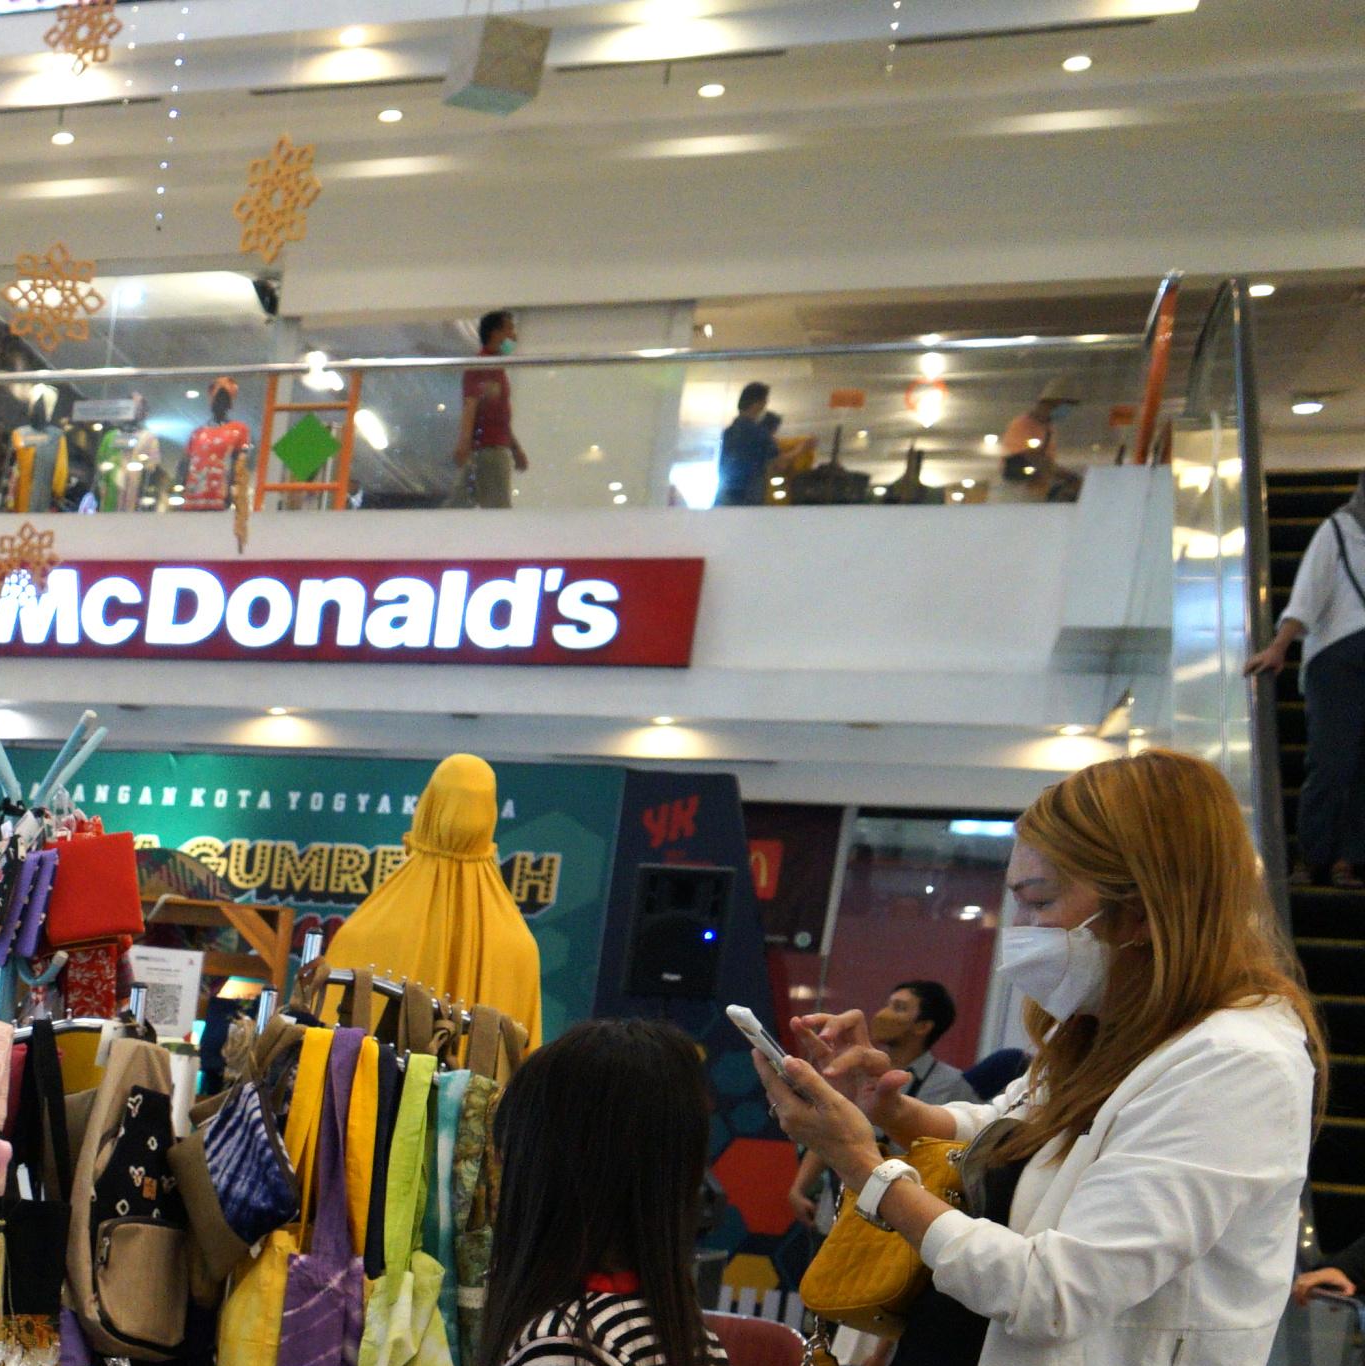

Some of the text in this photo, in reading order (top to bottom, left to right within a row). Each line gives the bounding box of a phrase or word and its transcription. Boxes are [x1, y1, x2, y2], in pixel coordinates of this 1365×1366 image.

[190, 786, 272, 810] KOTA
[287, 791, 517, 819] YOGYAKA
[183, 835, 562, 905] GUMREH
